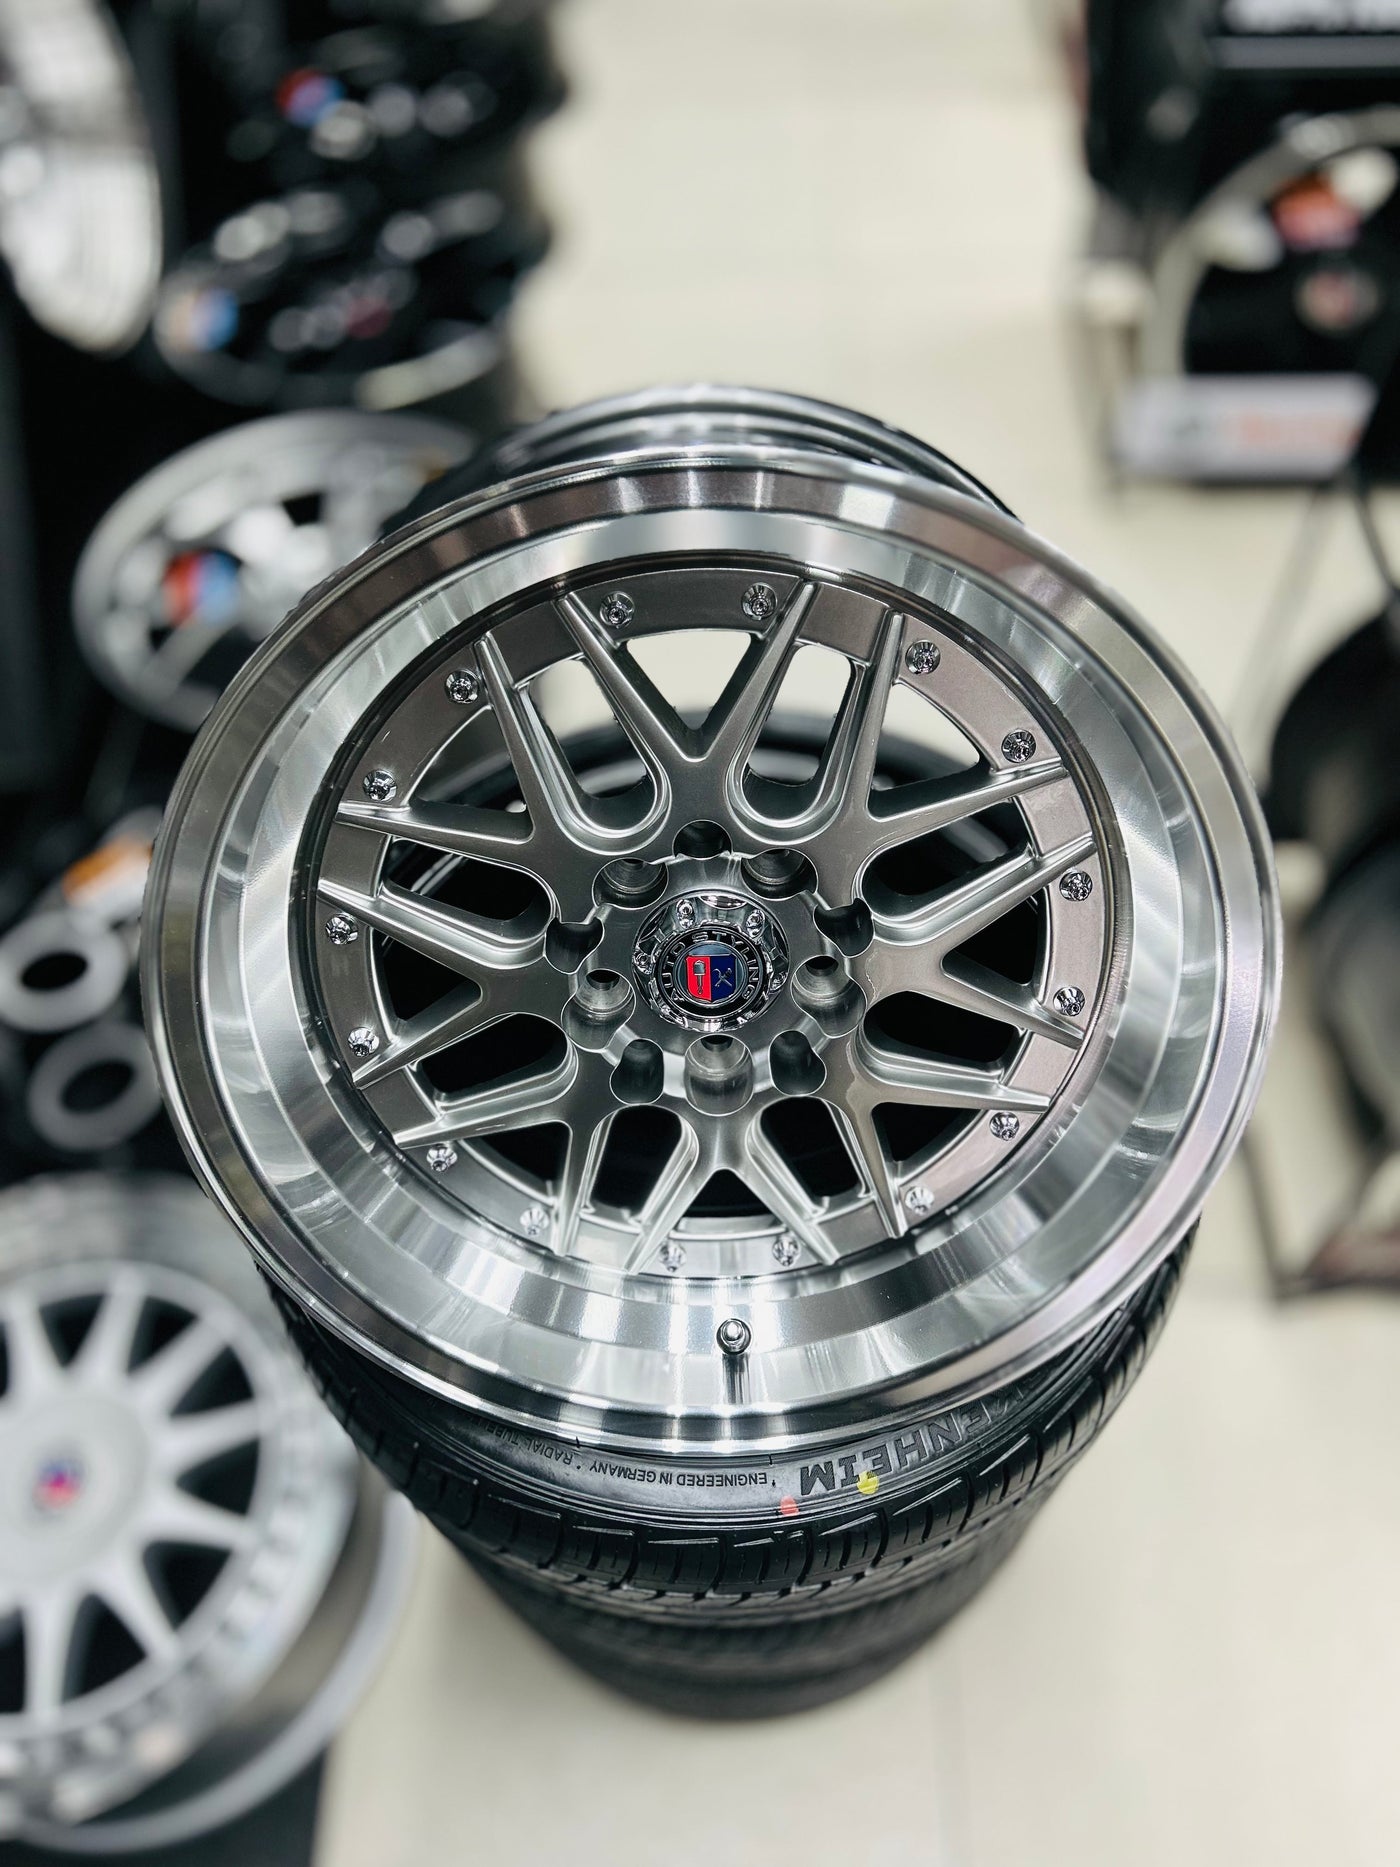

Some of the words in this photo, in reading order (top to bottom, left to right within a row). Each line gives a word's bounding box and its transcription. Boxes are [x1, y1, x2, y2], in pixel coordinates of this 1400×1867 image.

[526, 1439, 575, 1466] RADIAL
[589, 1460, 656, 1484] GERMANY
[659, 1471, 672, 1486] IN
[676, 1471, 768, 1488] ENGINEERED
